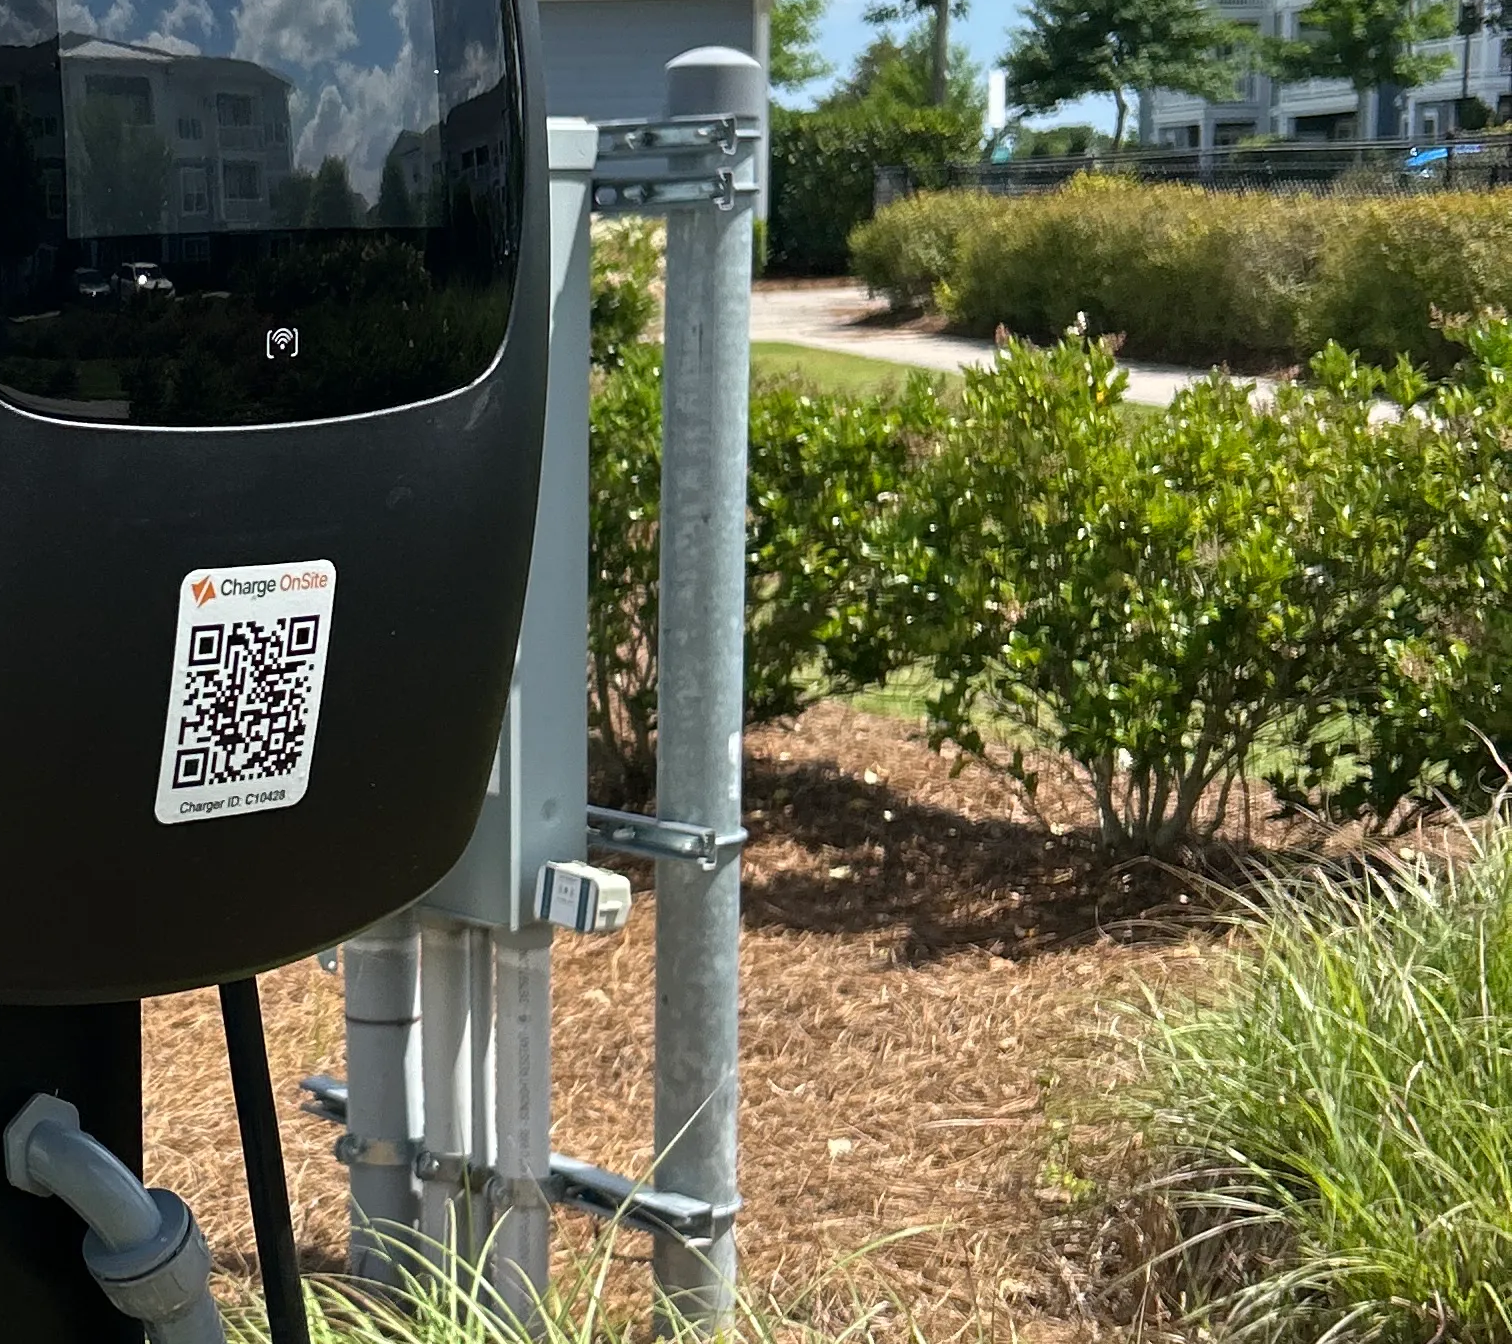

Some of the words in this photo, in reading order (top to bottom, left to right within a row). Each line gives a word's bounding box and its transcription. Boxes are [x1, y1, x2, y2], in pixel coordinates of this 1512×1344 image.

[221, 578, 277, 598] Charge
[279, 571, 329, 592] OnSite
[179, 800, 225, 814] Charger
[227, 795, 242, 808] ID:
